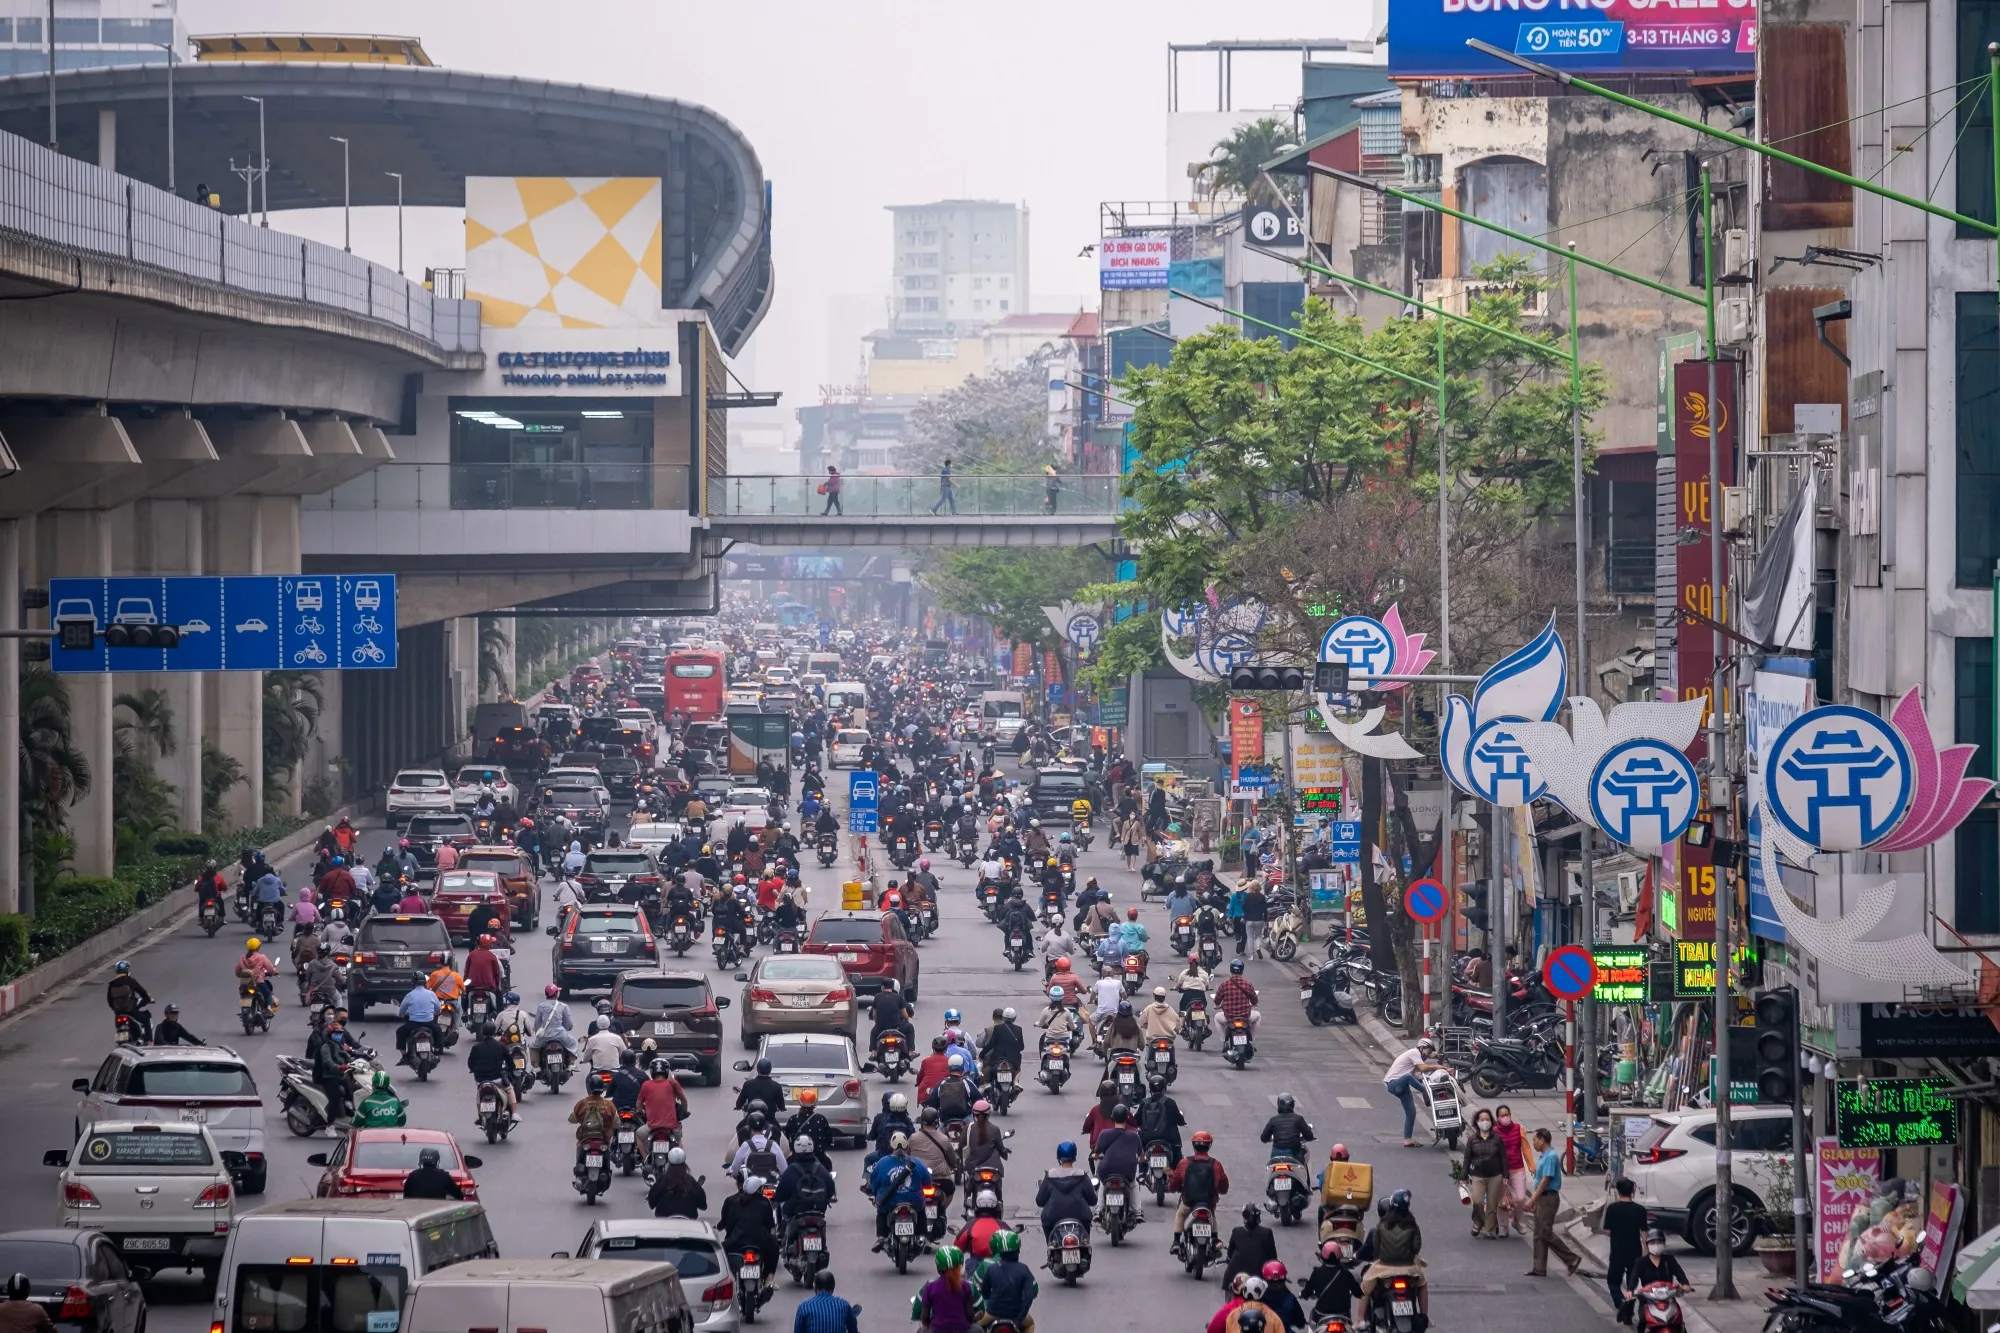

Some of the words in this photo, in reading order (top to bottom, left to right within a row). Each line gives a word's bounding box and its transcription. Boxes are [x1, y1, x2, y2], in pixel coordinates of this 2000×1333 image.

[1627, 30, 1657, 45] 3-13
[1660, 25, 1718, 44] THÁNG
[1722, 29, 1731, 44] 3
[1131, 256, 1160, 267] NHUNG
[605, 372, 667, 386] STATION
[371, 1106, 397, 1117] Grab
[116, 1147, 141, 1155] KARAOKE
[1824, 1200, 1852, 1216] CHIẾT
[367, 1256, 375, 1264] XE
[373, 1322, 389, 1330] BUS
